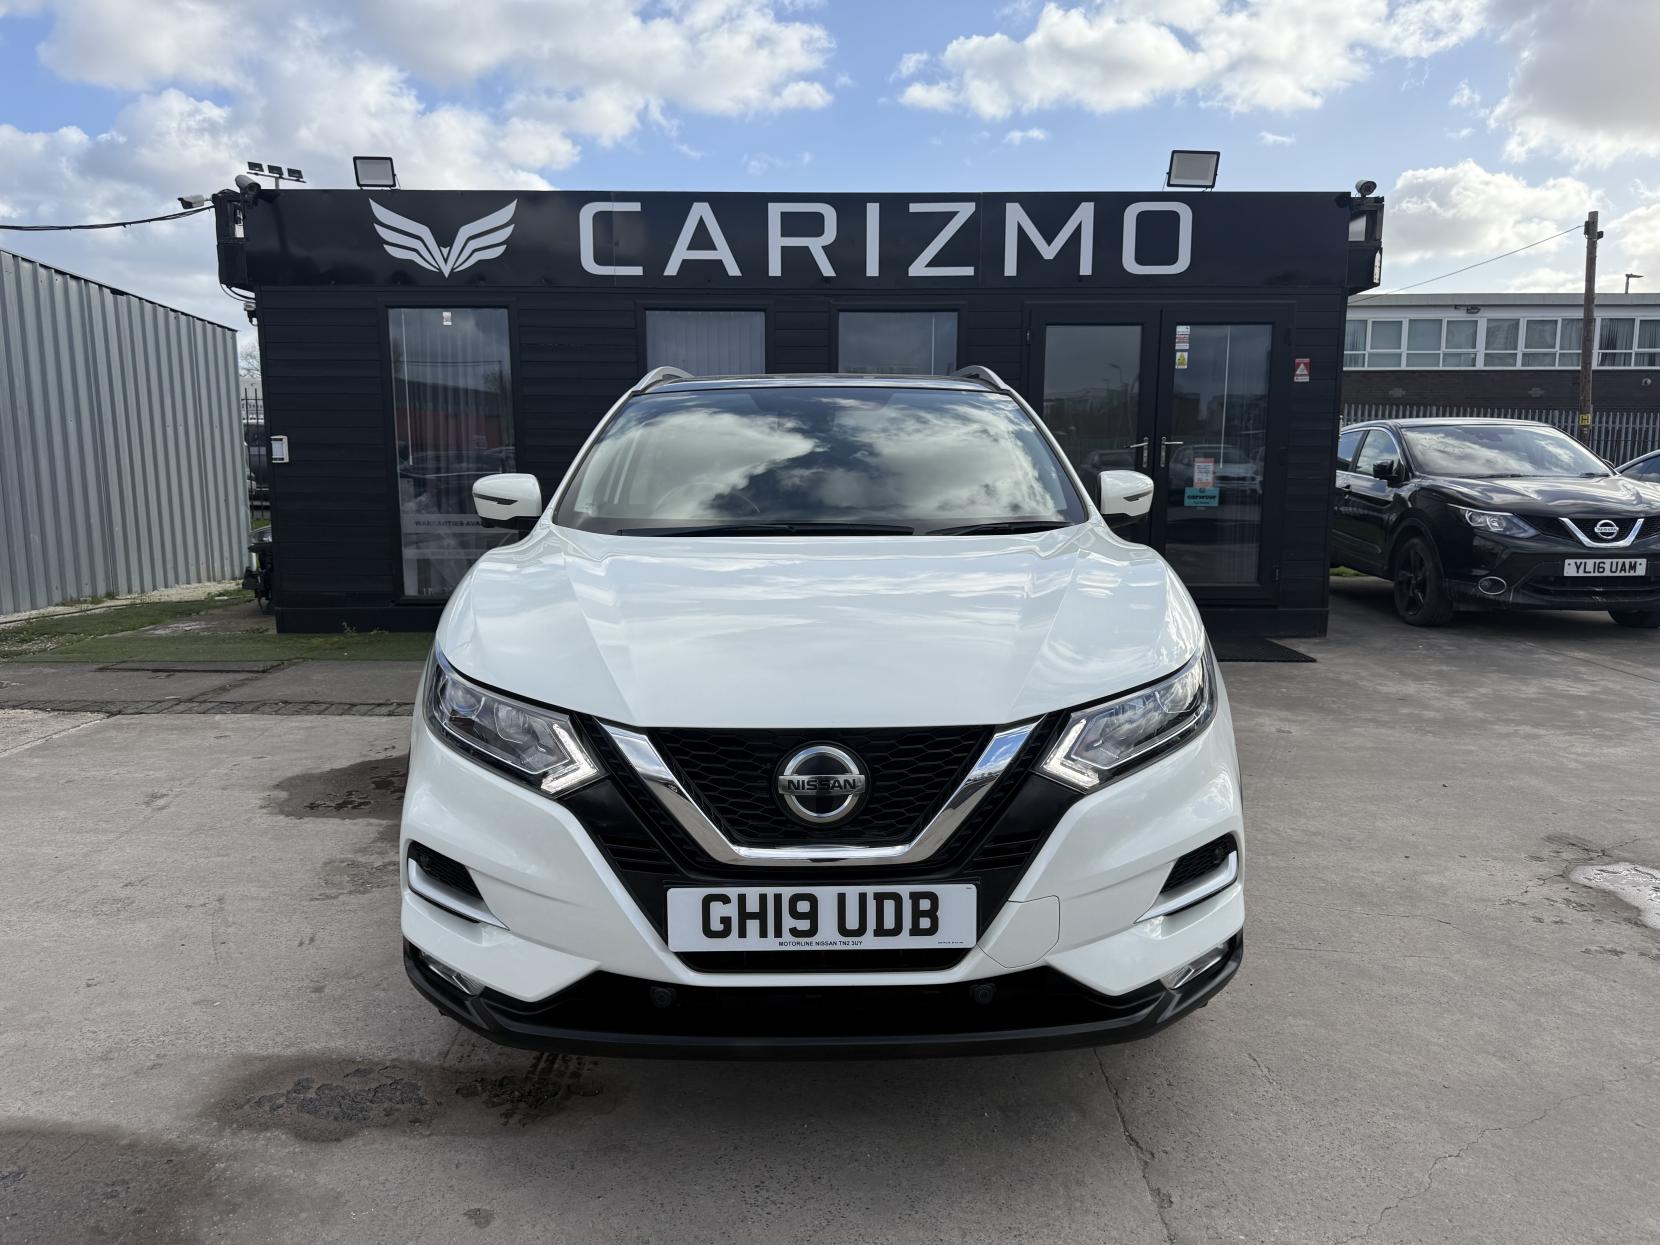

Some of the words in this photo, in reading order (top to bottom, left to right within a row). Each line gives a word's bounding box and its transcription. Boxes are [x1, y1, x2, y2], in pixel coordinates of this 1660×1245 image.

[579, 201, 1193, 277] CARIZMO
[1574, 561, 1606, 574] YL16
[1609, 561, 1638, 574] UAM
[788, 779, 856, 791] NISSAN
[701, 892, 819, 939] GH19
[836, 890, 940, 938] UDB
